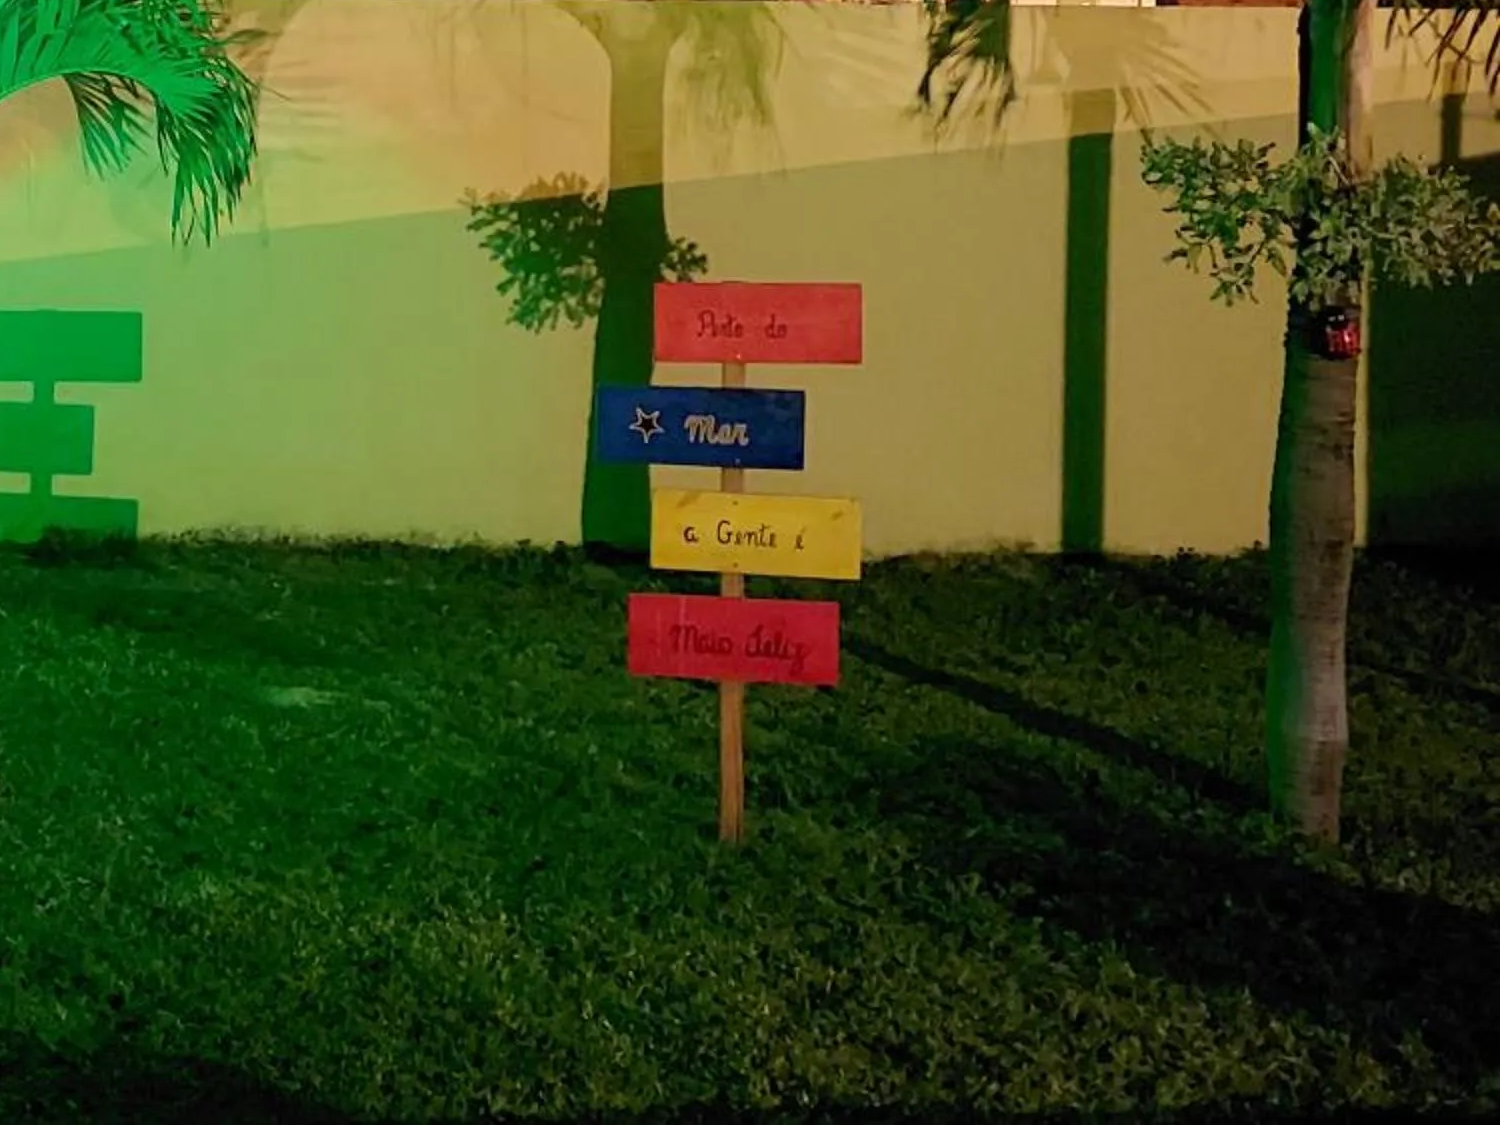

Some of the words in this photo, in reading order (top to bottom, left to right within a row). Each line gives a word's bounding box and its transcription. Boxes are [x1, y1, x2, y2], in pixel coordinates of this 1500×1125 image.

[764, 313, 788, 339] do
[684, 414, 749, 446] Mar
[683, 526, 699, 544] a
[717, 520, 777, 549] Gente
